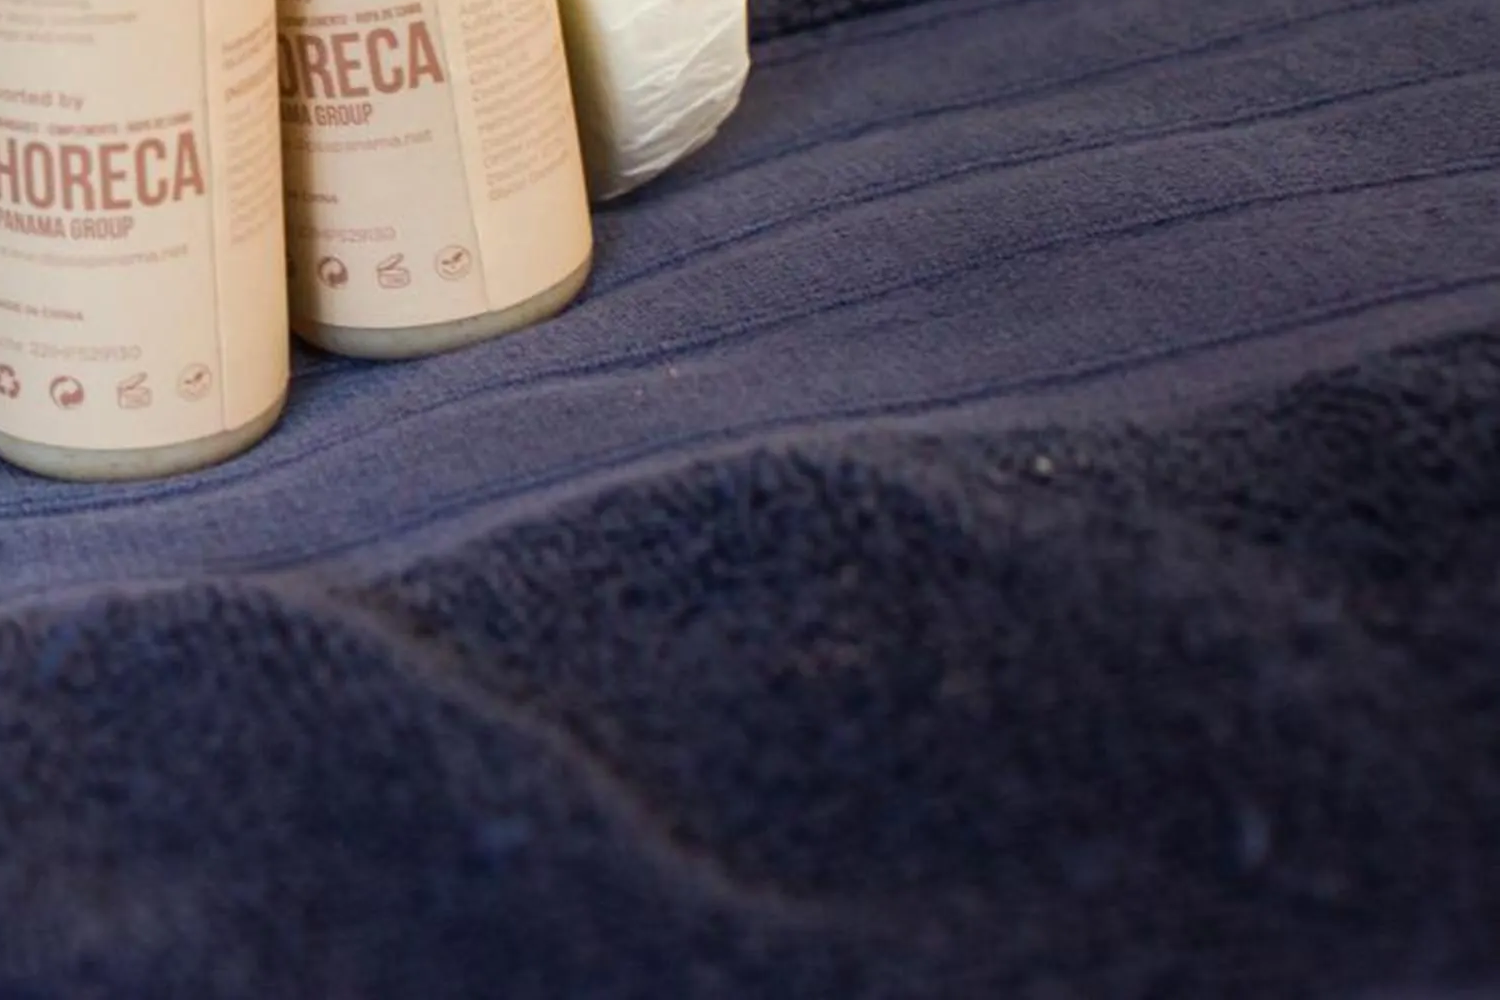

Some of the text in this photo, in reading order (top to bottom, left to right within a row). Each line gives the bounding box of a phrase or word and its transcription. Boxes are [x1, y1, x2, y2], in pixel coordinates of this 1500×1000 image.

[276, 20, 445, 99] ORECA
[314, 102, 373, 127] GROUP
[70, 215, 135, 241] GROUP
